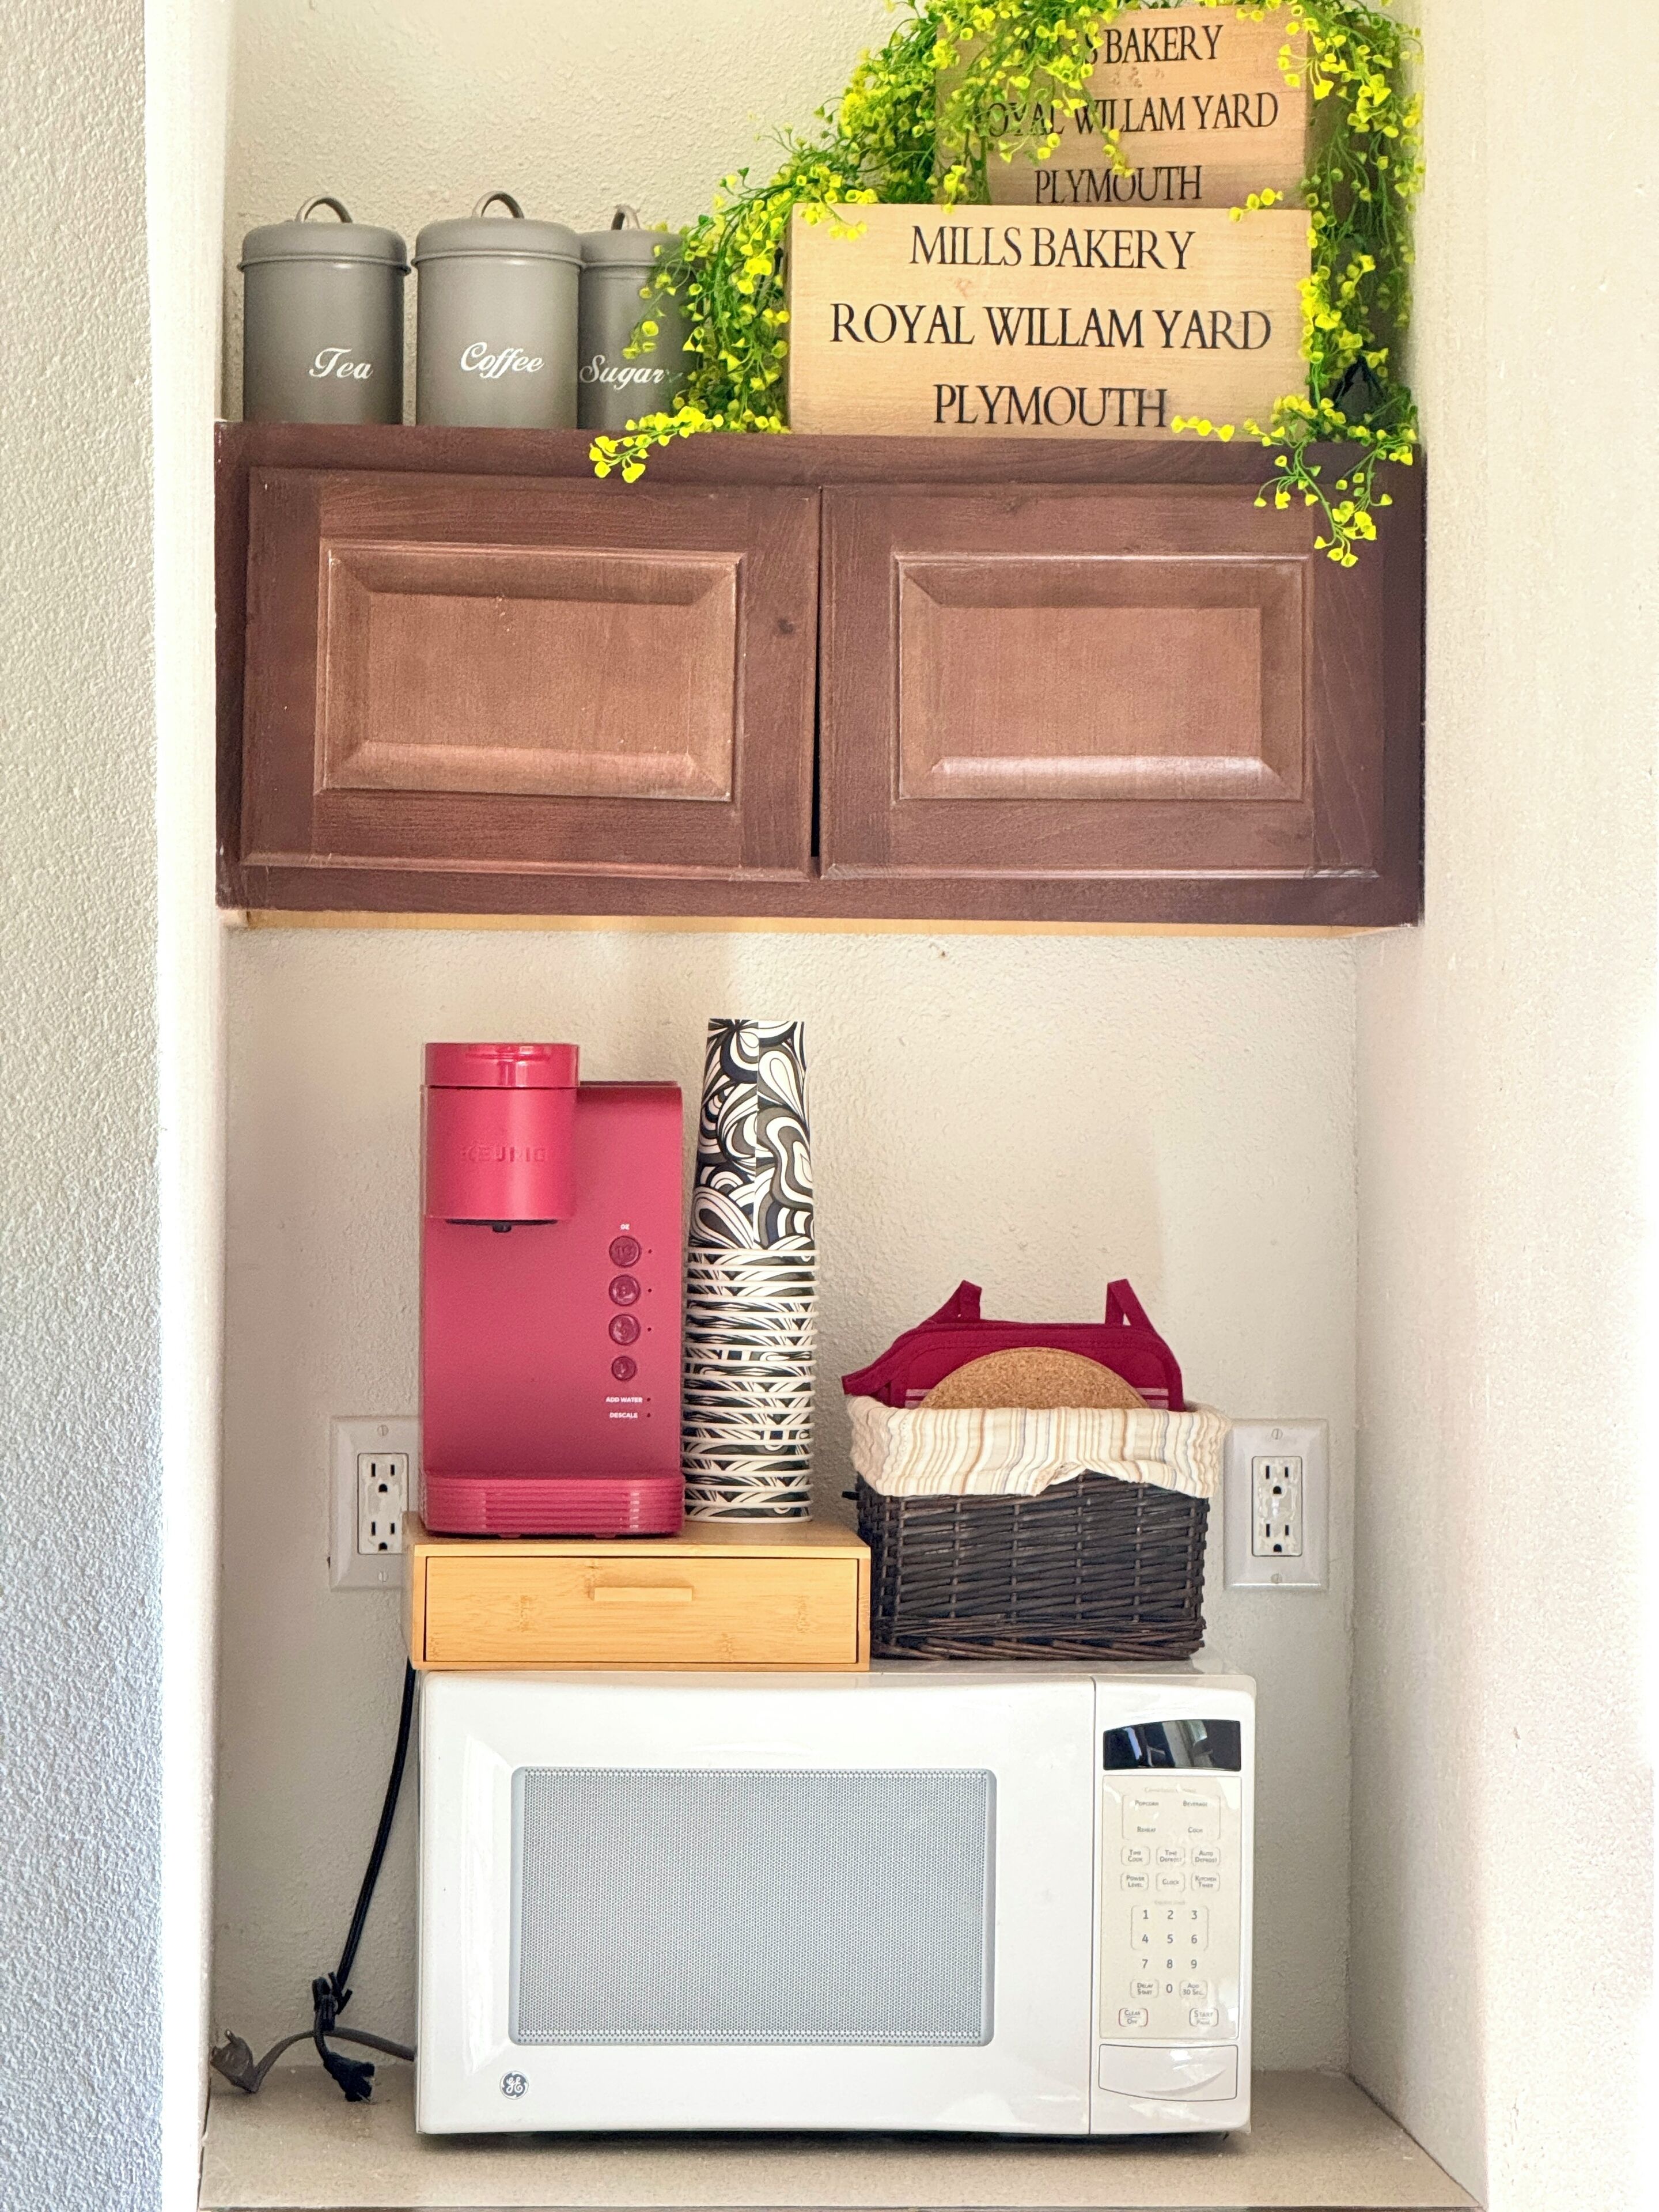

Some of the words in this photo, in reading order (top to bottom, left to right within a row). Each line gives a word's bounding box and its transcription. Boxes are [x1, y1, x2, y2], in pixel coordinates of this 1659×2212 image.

[1103, 24, 1224, 65] BAKERY
[1192, 92, 1278, 130] YARD
[1035, 165, 1202, 204] PLYMOUTH
[909, 225, 1022, 267] MILLS
[1030, 228, 1196, 270] BAKERY
[830, 303, 975, 345] ROYAL
[982, 306, 1145, 349] WILLAM
[1152, 309, 1272, 350] YARD
[308, 347, 373, 379] Tea
[460, 342, 544, 379] Coffee
[579, 354, 665, 391] Sugar
[933, 384, 1167, 427] PLYMOUTH
[1142, 1910, 1149, 1919] 1
[1167, 1910, 1173, 1919] 2
[1191, 1910, 1198, 1920] 3
[1142, 1934, 1149, 1944] 4
[1167, 1934, 1173, 1944] 5
[1191, 1934, 1198, 1944] 6
[1142, 1959, 1148, 1969] 7
[1166, 1959, 1173, 1969] 8
[1191, 1959, 1197, 1969] 9
[1166, 1983, 1173, 1993] 0
